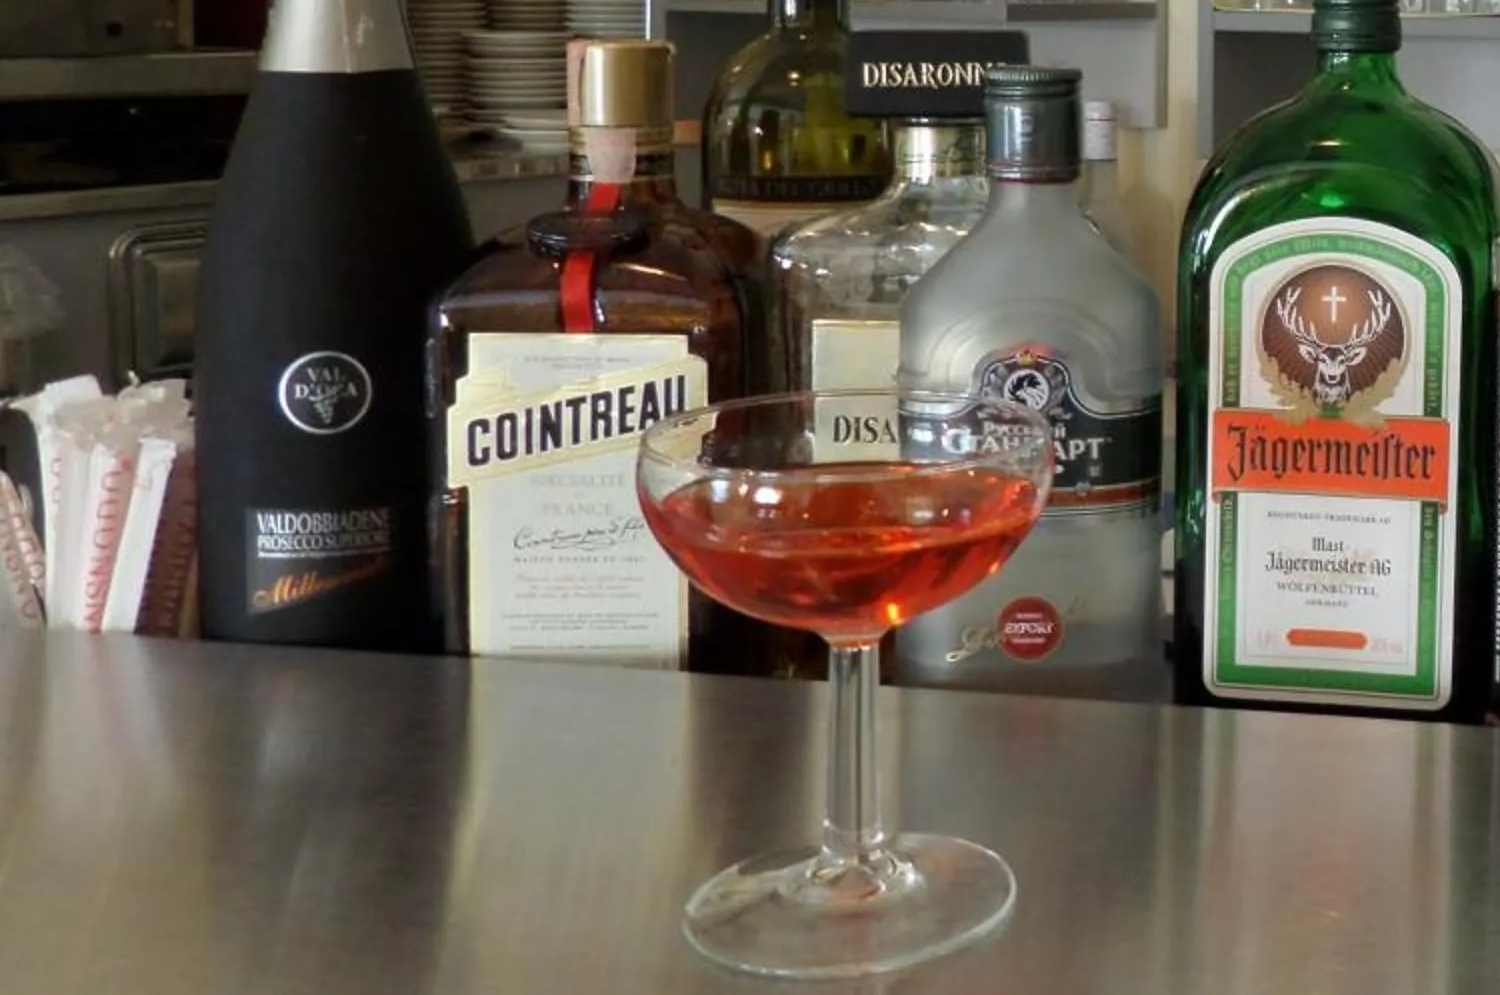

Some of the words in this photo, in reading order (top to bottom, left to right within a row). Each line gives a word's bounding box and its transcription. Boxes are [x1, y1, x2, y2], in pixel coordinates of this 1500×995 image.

[863, 62, 1006, 89] DISARONN
[467, 374, 686, 468] COINTREAU
[832, 414, 898, 444] DISA
[257, 507, 391, 534] VALDOBBIADENE
[257, 534, 323, 551] PROSECCO
